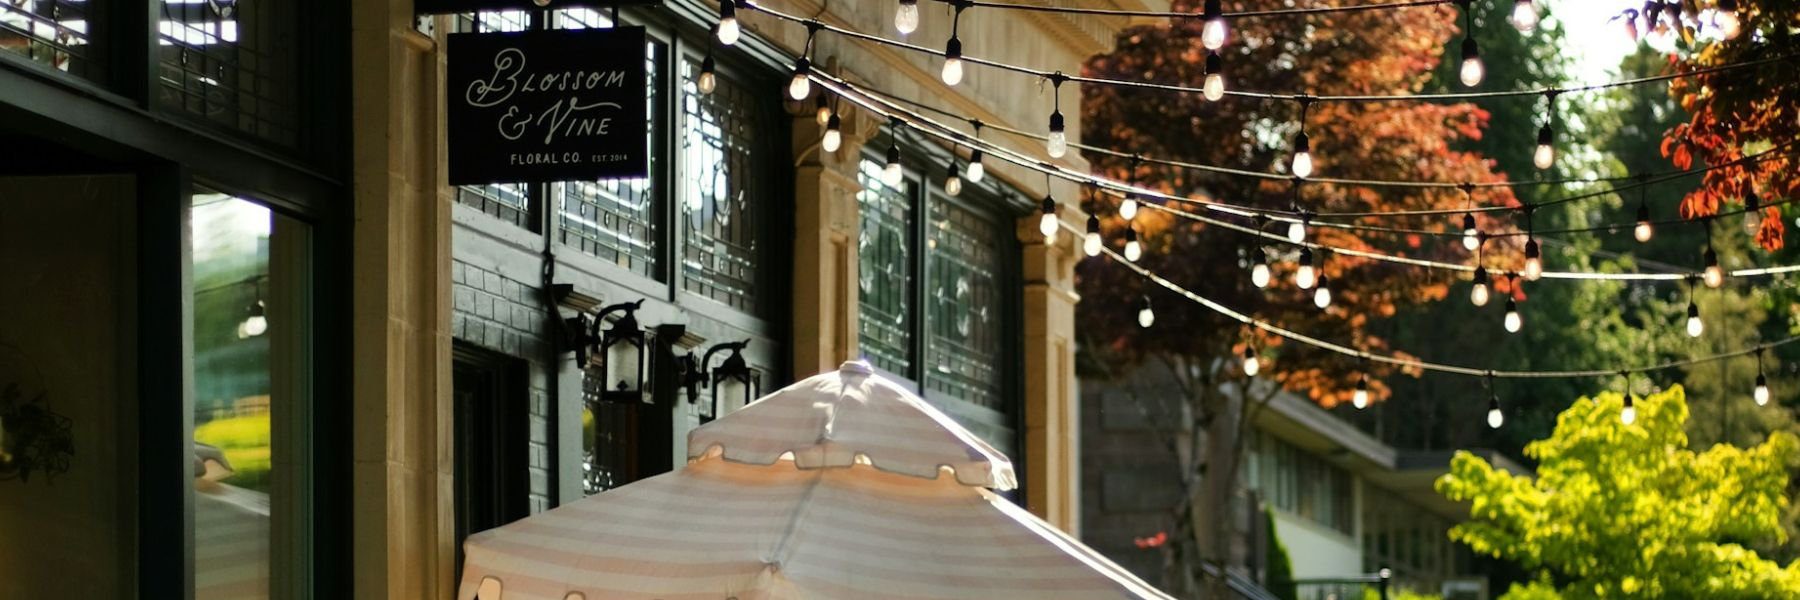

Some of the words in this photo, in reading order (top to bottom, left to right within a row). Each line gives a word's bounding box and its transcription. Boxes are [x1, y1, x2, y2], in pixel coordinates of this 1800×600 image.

[499, 105, 532, 140] &
[511, 152, 558, 165] FLORAL
[563, 151, 582, 164] CO.
